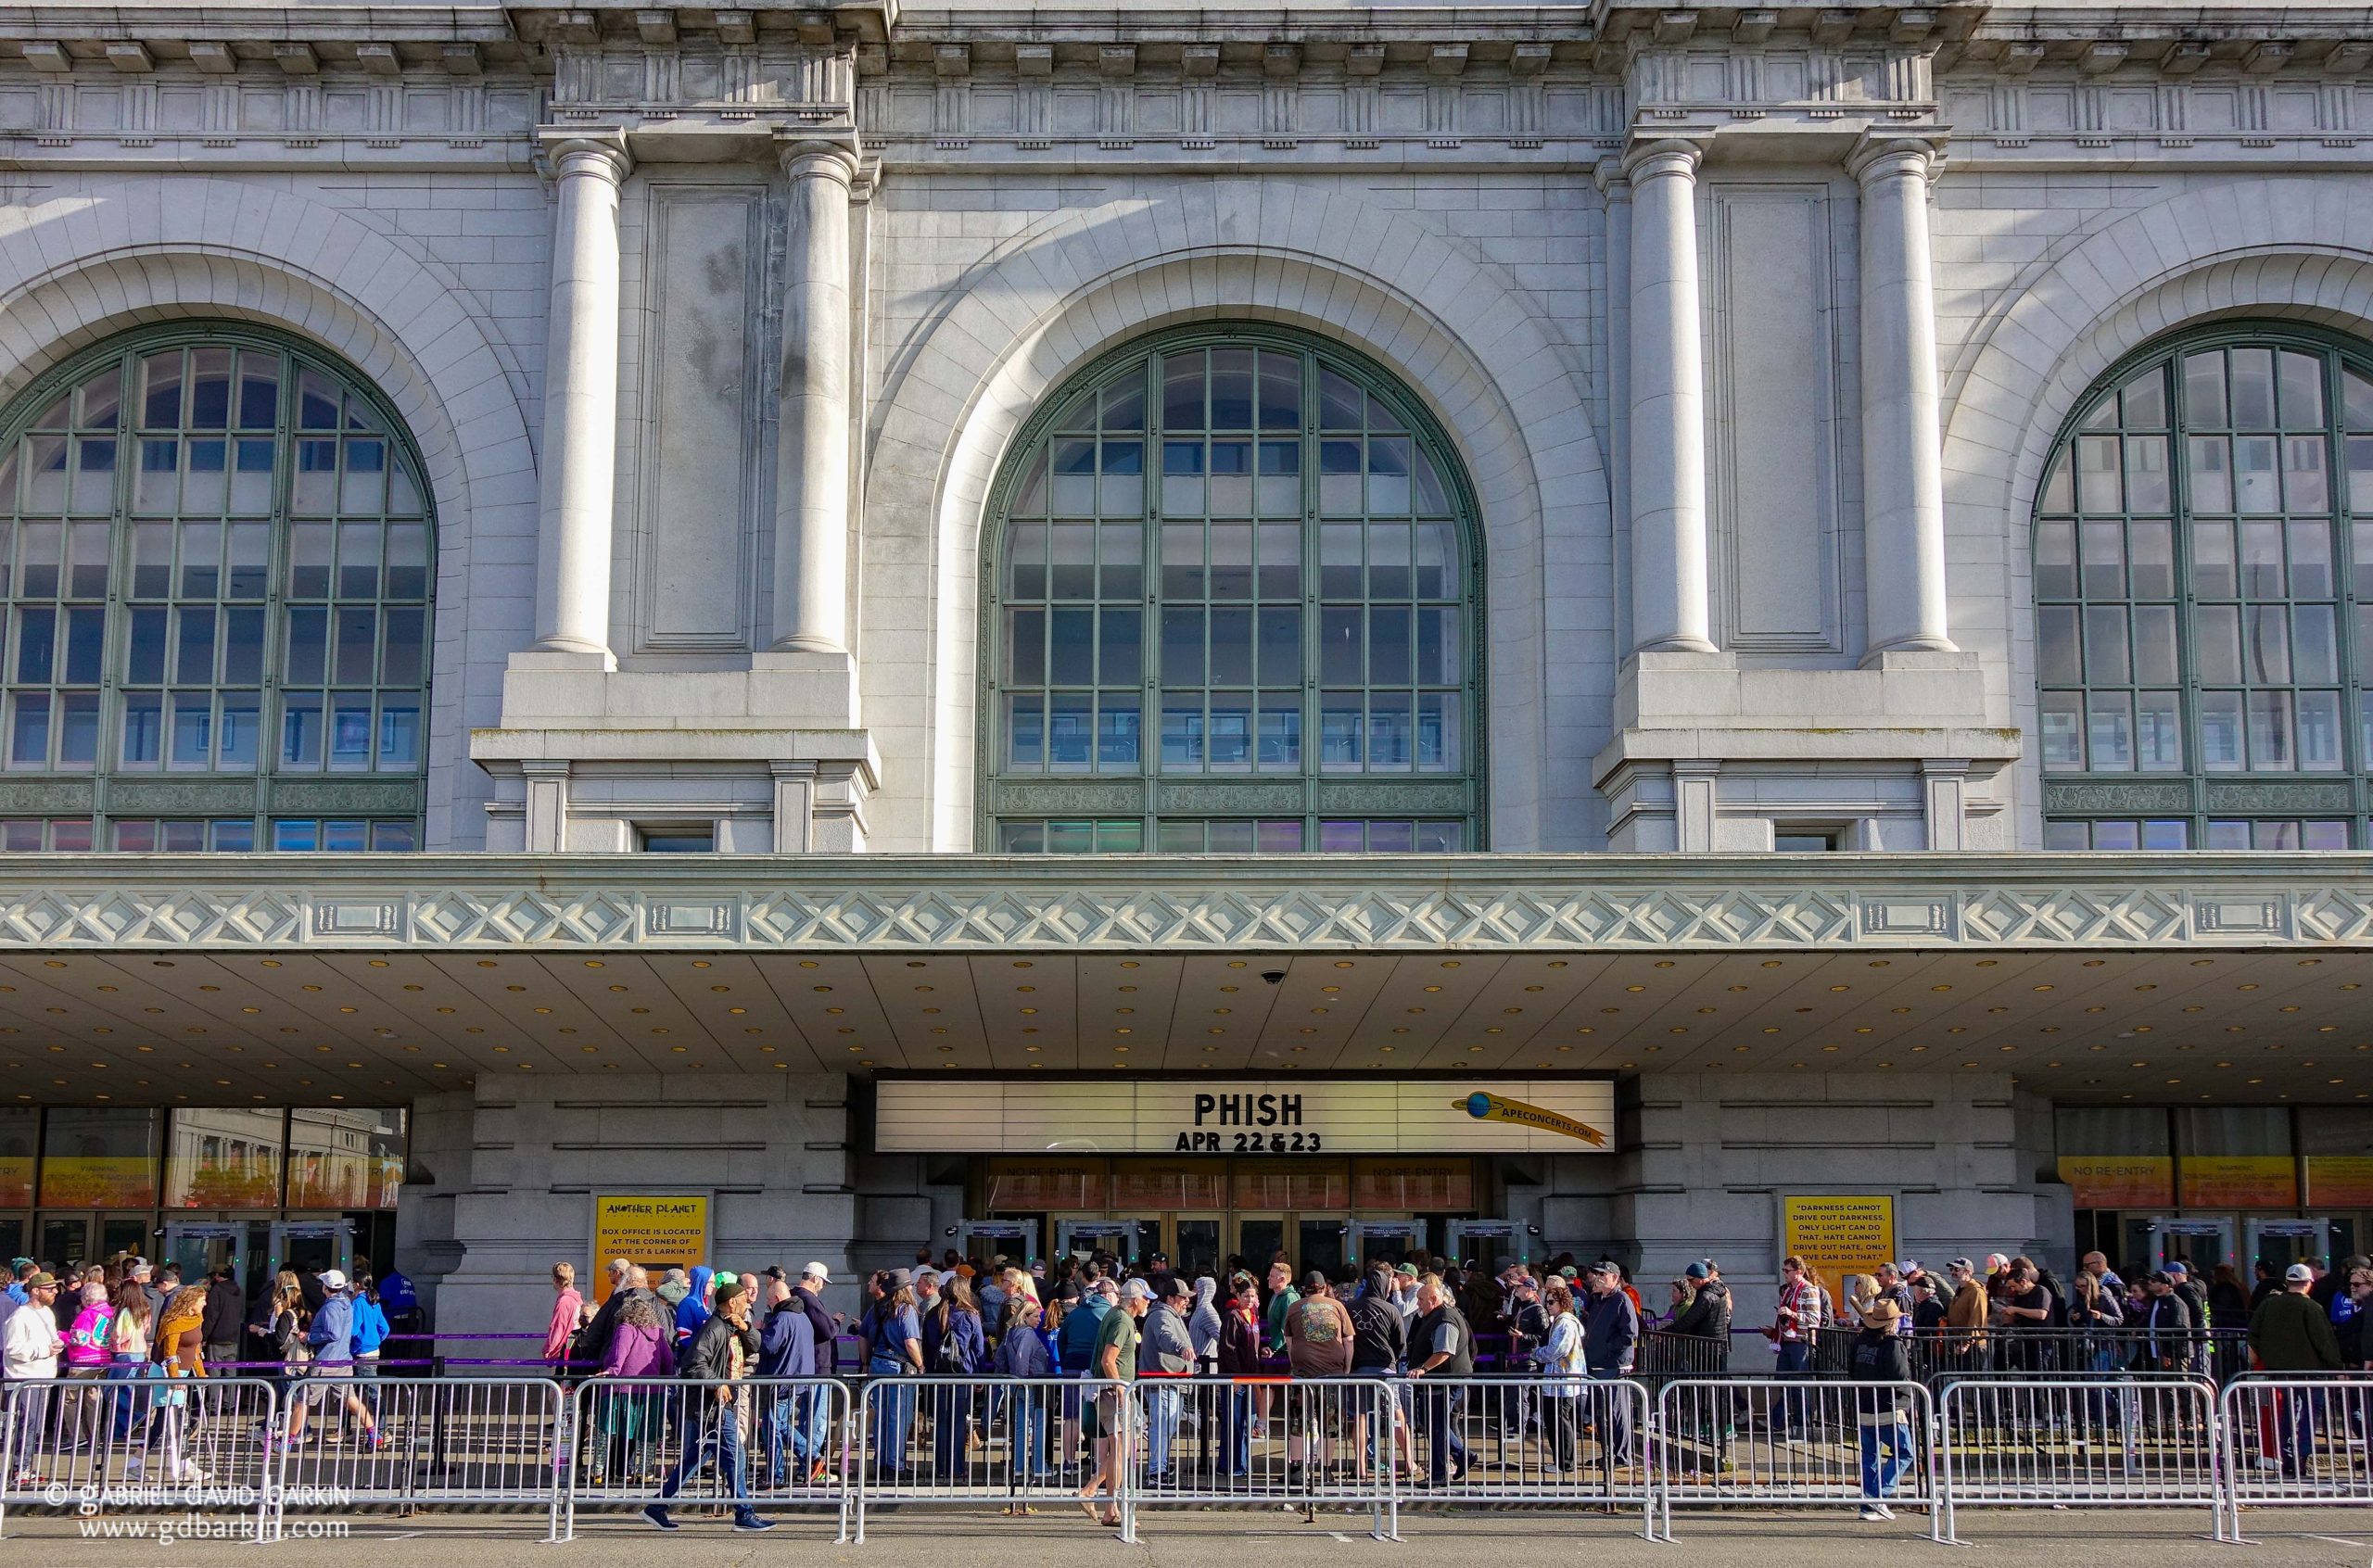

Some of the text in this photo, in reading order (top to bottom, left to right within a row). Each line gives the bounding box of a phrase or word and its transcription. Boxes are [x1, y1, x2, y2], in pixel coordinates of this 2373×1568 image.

[1195, 1094, 1302, 1126] PHISH
[1502, 1107, 1593, 1140] APECONCERTS.COM
[1175, 1132, 1221, 1151] APR
[1008, 1167, 1025, 1176] NO
[1374, 1168, 1391, 1176] NO
[2074, 1166, 2155, 1176] NO RE-ENTRY
[606, 1204, 697, 1214] ANOTHER PLANET
